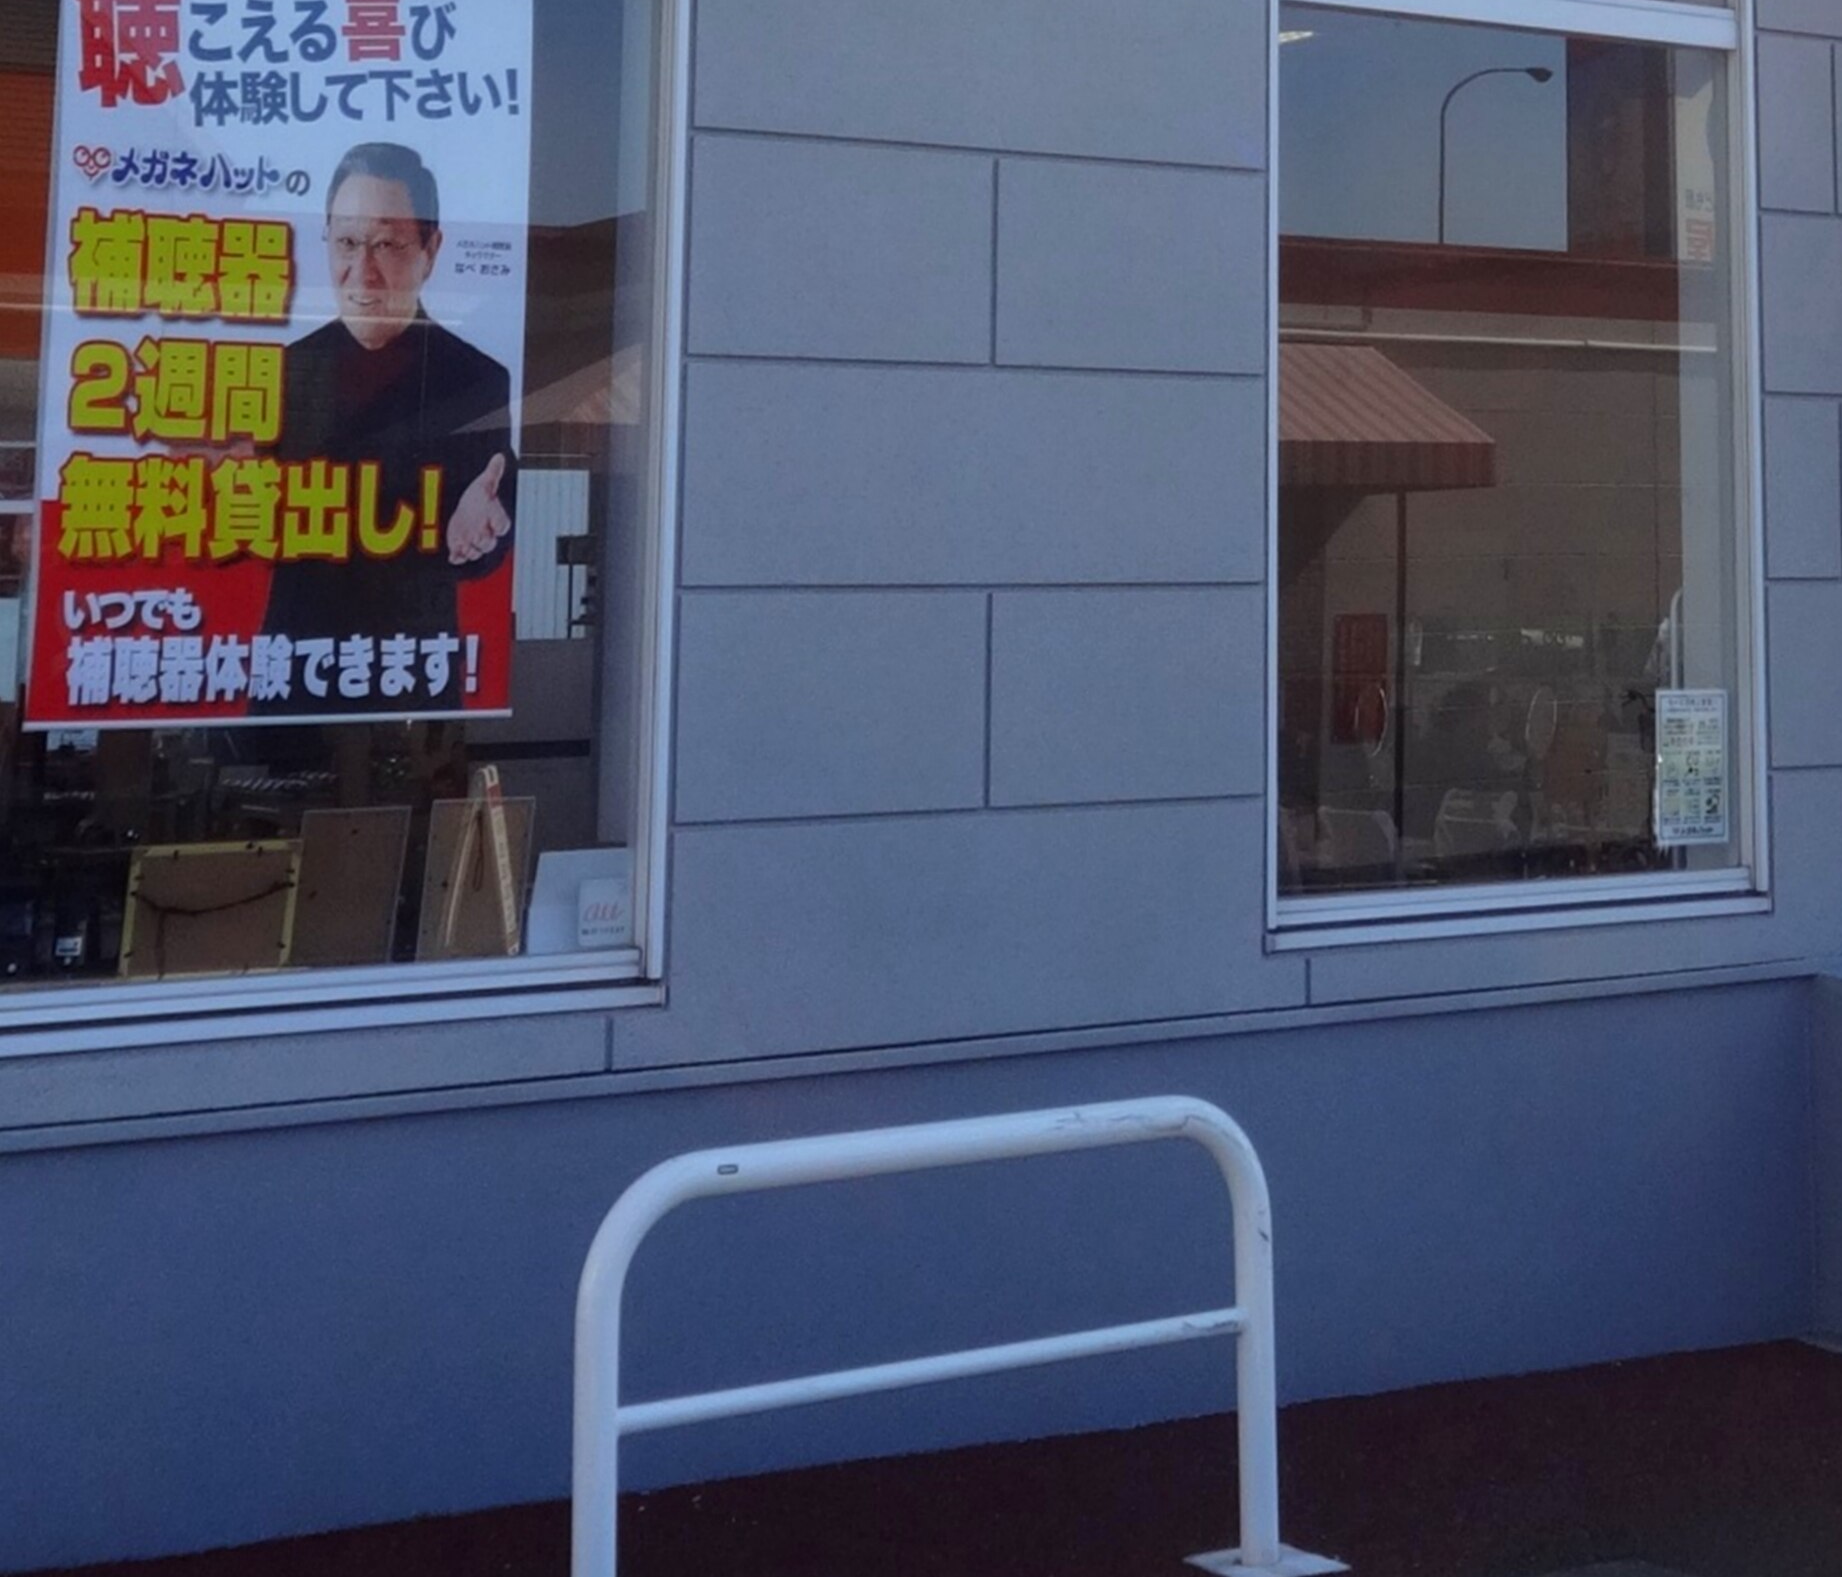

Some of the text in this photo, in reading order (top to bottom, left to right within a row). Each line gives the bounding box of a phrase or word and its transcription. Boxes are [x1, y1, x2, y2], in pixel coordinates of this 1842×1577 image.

[190, 69, 520, 127] 体験して下さい!
[68, 207, 293, 321] 補聴器
[68, 337, 286, 445] 2週間
[57, 454, 444, 562] 無料貸出し!
[63, 587, 202, 632] いつでも
[66, 633, 479, 707] 補聴器体験できます!
